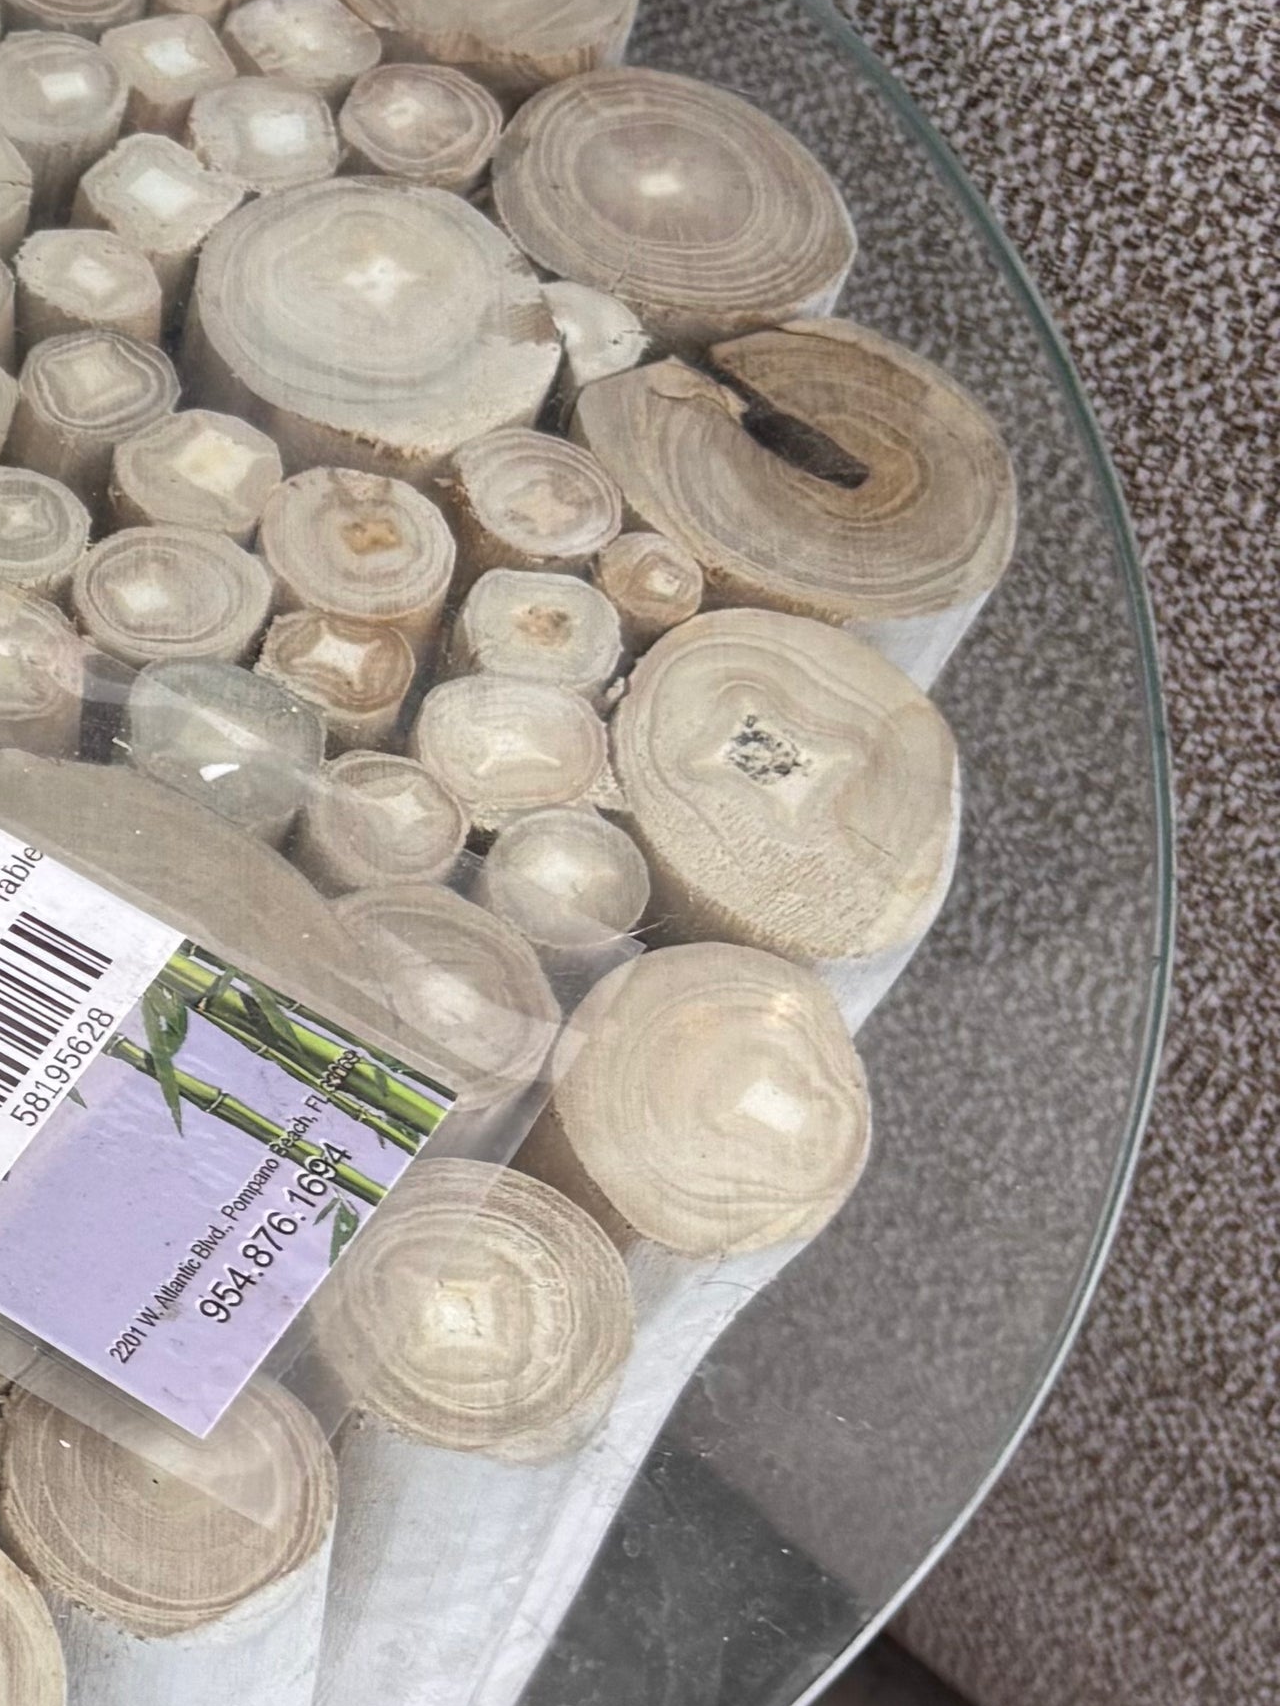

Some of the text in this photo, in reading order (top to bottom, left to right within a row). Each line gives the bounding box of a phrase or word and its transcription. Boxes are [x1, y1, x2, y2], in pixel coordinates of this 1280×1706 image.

[9, 1007, 115, 1127] 58195628
[109, 1325, 148, 1364] 2201
[136, 1306, 165, 1328] W.
[156, 1258, 202, 1310] Atlantic
[190, 1224, 235, 1261] Blvd.,
[220, 1158, 280, 1223] Pompano
[268, 1111, 319, 1157] Beach,
[304, 1094, 330, 1113] FL
[198, 1141, 353, 1324] 954.876.1694
